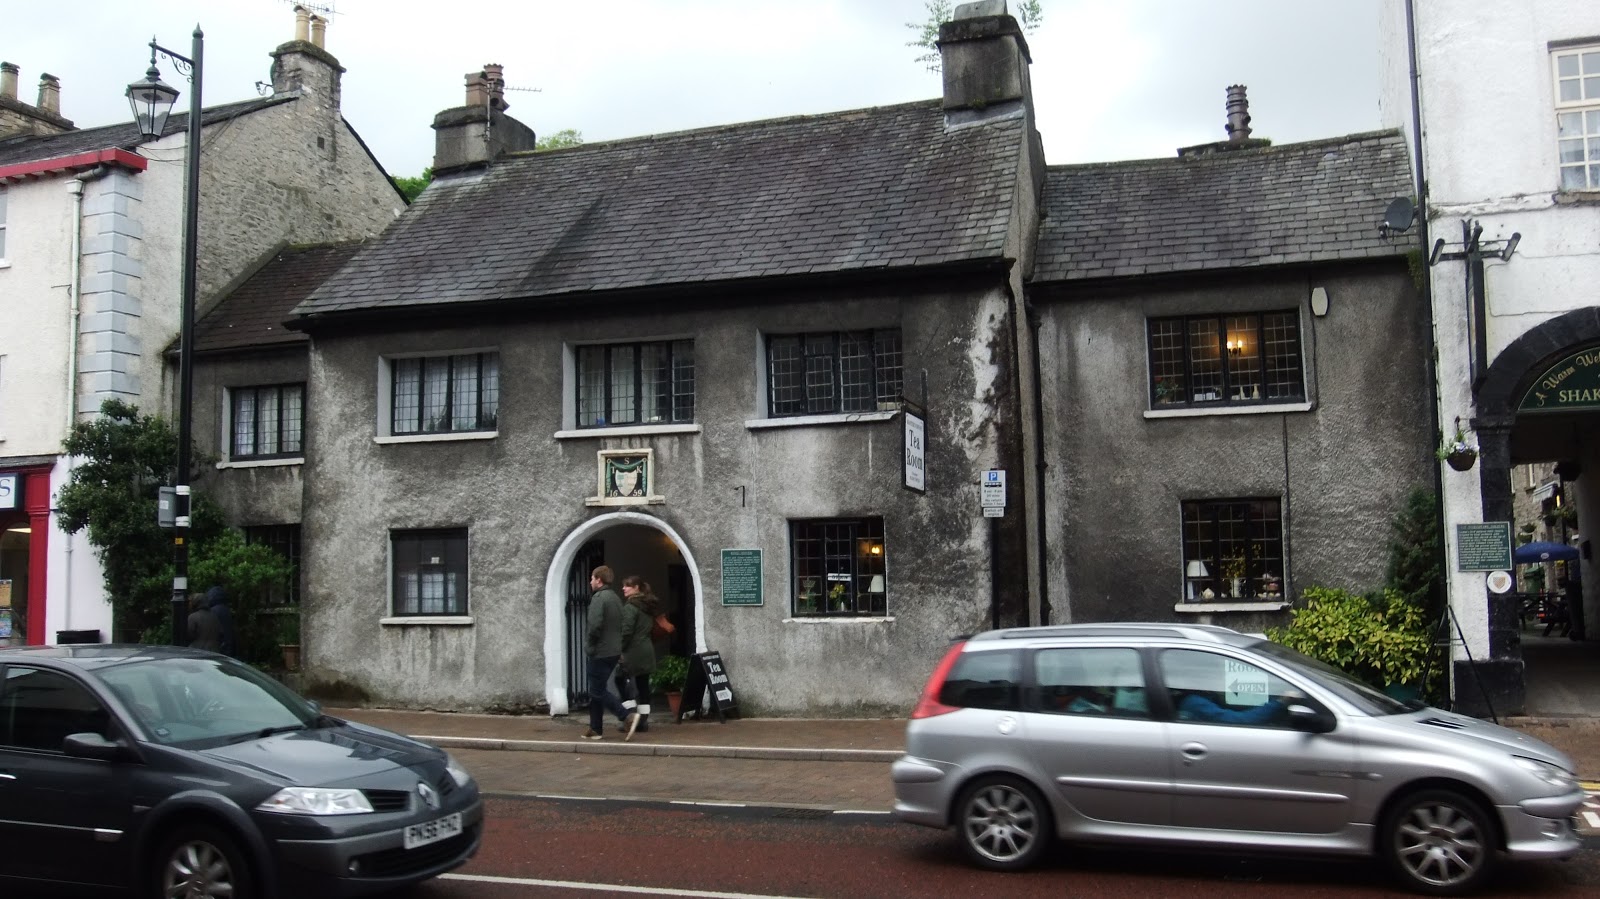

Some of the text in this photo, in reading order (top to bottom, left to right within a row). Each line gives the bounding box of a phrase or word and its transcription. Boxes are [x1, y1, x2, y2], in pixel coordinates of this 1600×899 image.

[1542, 366, 1576, 390] Warm
[1558, 388, 1600, 403] SHAK
[908, 429, 921, 451] Tea
[624, 457, 630, 465] S
[906, 447, 923, 471] Room
[636, 465, 643, 474] K
[632, 489, 643, 497] 59
[707, 661, 722, 673] Tea
[708, 673, 728, 685] Room
[1236, 683, 1265, 692] OPEN
